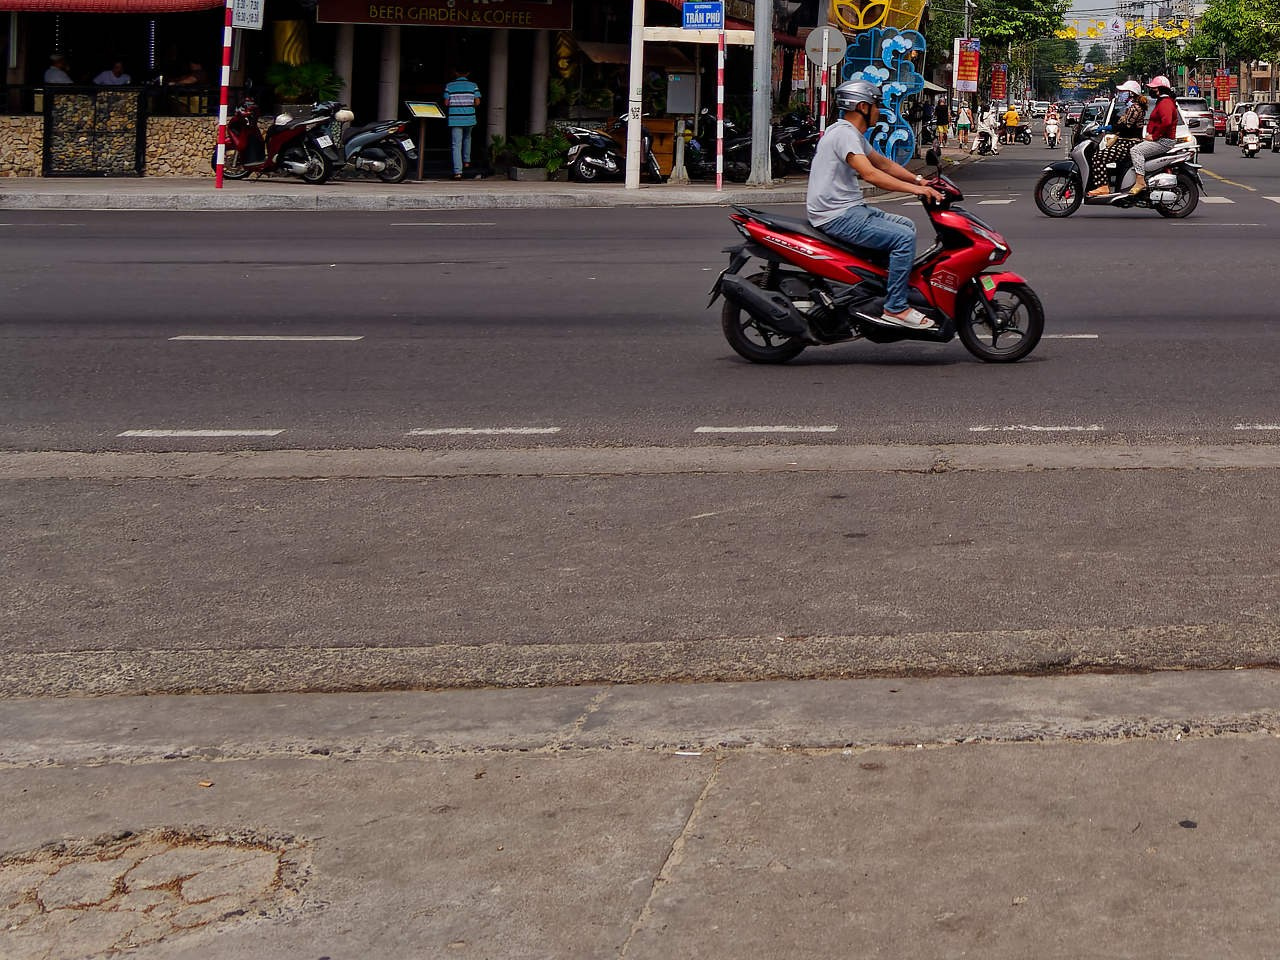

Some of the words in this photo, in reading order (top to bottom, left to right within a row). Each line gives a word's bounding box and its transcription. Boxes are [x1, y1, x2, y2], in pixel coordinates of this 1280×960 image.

[369, 5, 403, 20] BEER
[408, 7, 470, 22] GARDEN
[472, 13, 481, 22] &
[483, 9, 532, 25] COFFEE
